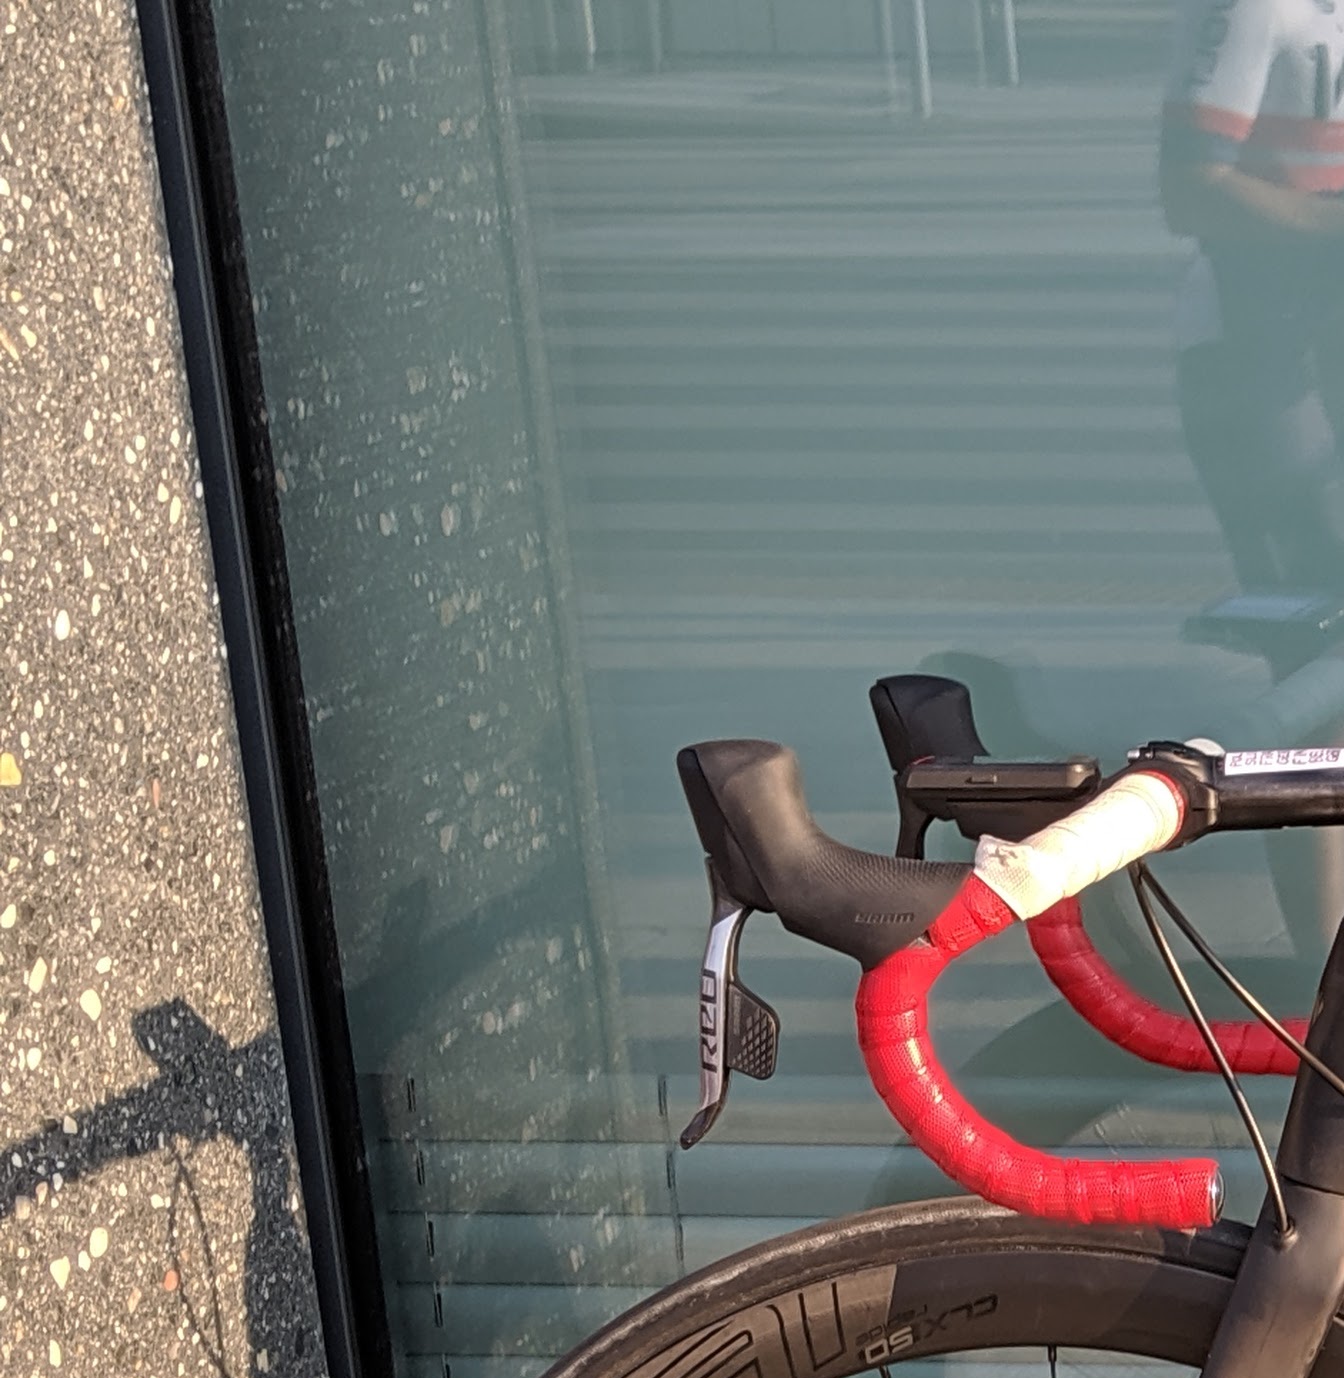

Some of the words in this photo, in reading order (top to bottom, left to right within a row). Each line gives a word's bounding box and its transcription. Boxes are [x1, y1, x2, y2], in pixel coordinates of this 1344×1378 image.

[700, 968, 718, 1073] RED
[922, 1293, 999, 1341] CLX
[864, 1325, 914, 1365] 50
